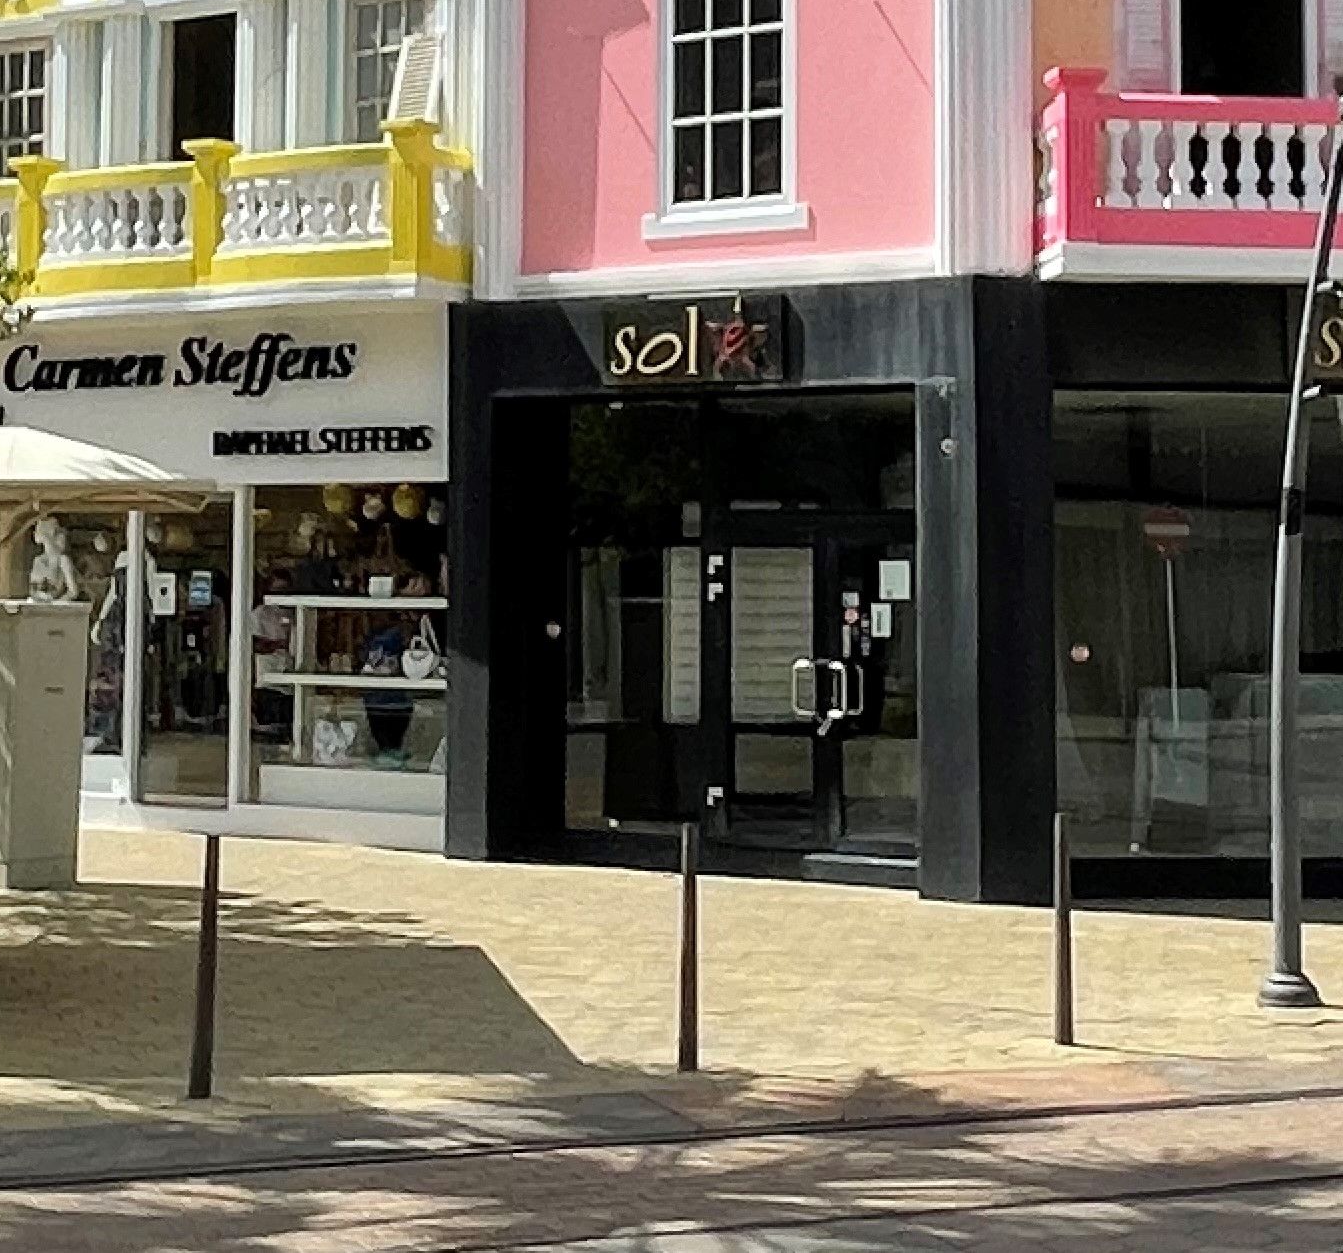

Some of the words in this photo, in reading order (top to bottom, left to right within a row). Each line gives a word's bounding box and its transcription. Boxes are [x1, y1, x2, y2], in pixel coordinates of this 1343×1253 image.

[5, 345, 165, 391] Carmen
[173, 333, 357, 396] Steffens
[319, 425, 433, 453] STEFFENS
